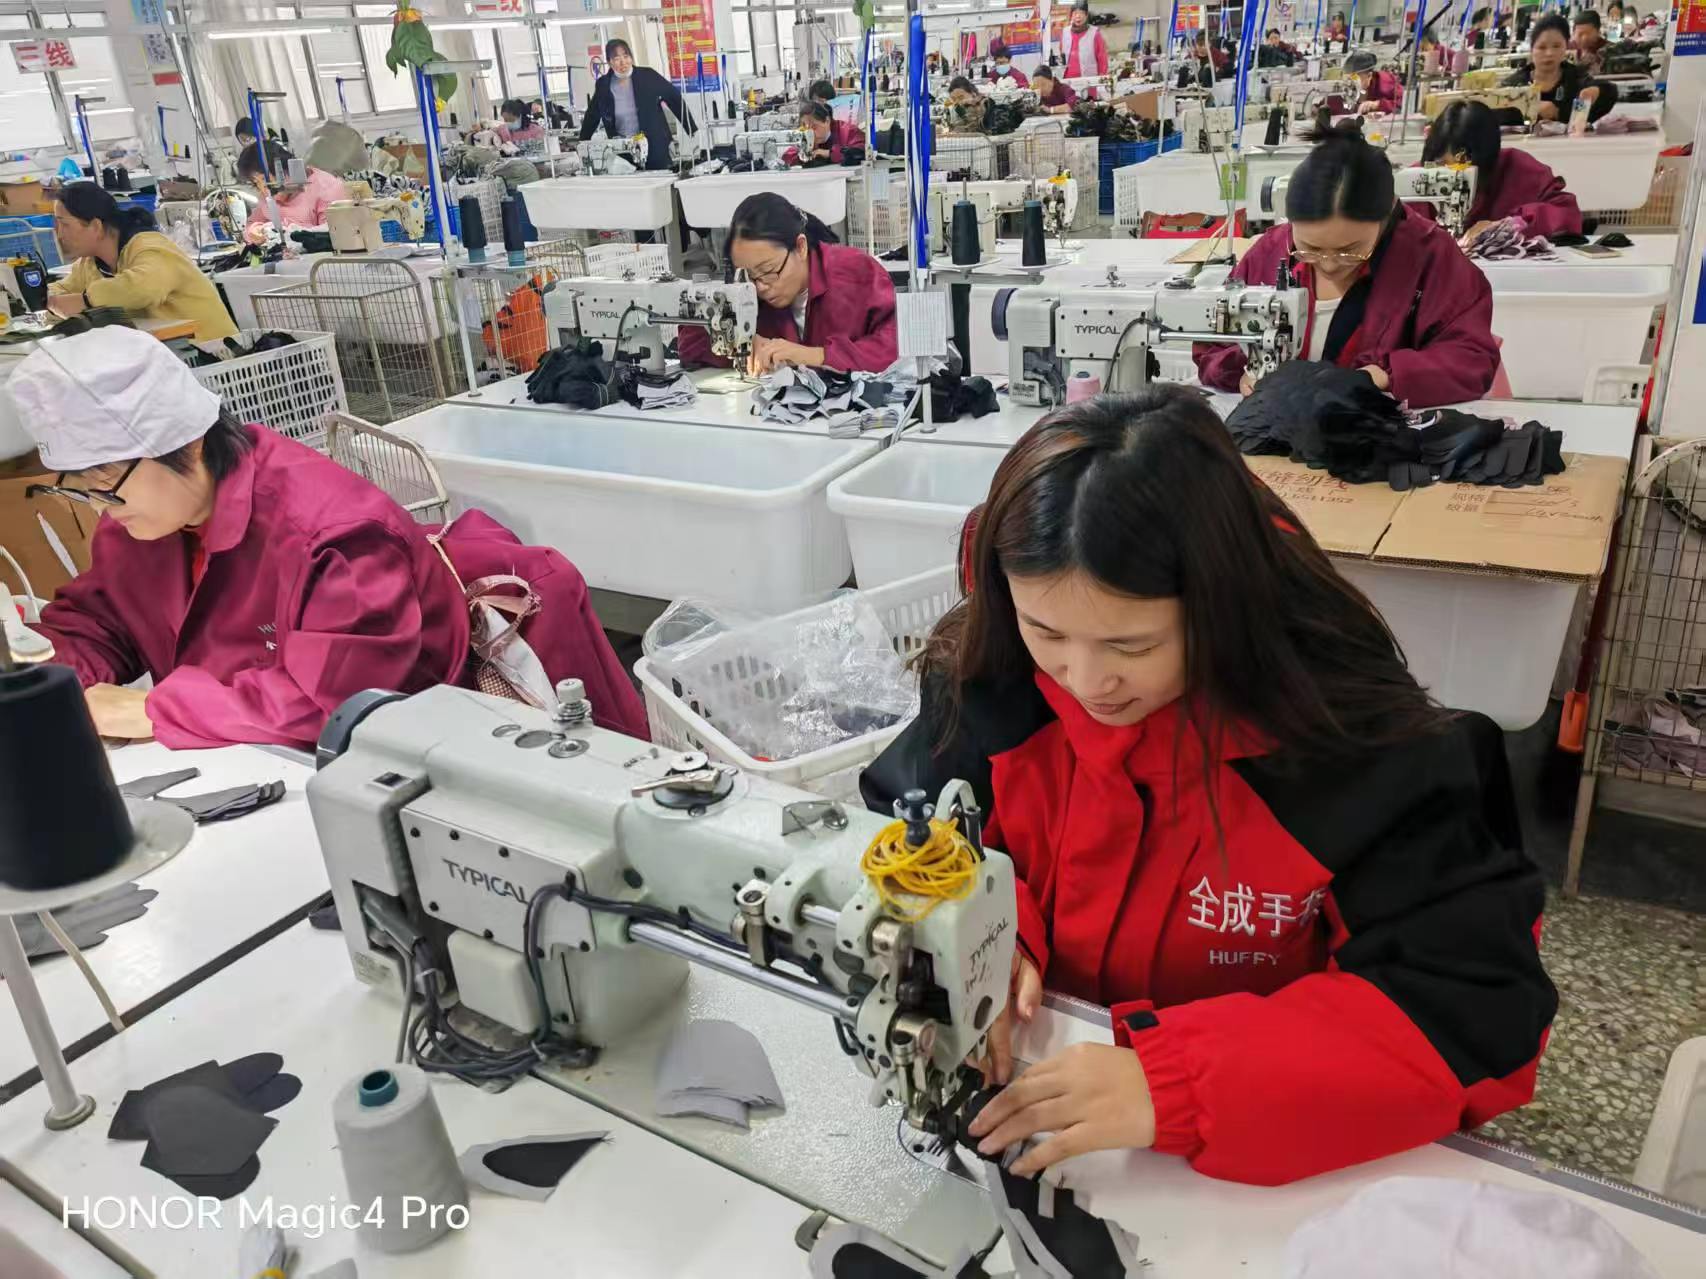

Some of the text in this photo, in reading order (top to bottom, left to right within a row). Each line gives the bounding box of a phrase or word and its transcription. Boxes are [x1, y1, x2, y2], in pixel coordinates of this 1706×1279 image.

[590, 310, 621, 319] TYPICAL
[1074, 324, 1121, 335] TYPICAL
[442, 857, 529, 905] TYPICAL
[1209, 949, 1280, 966] HUFFY
